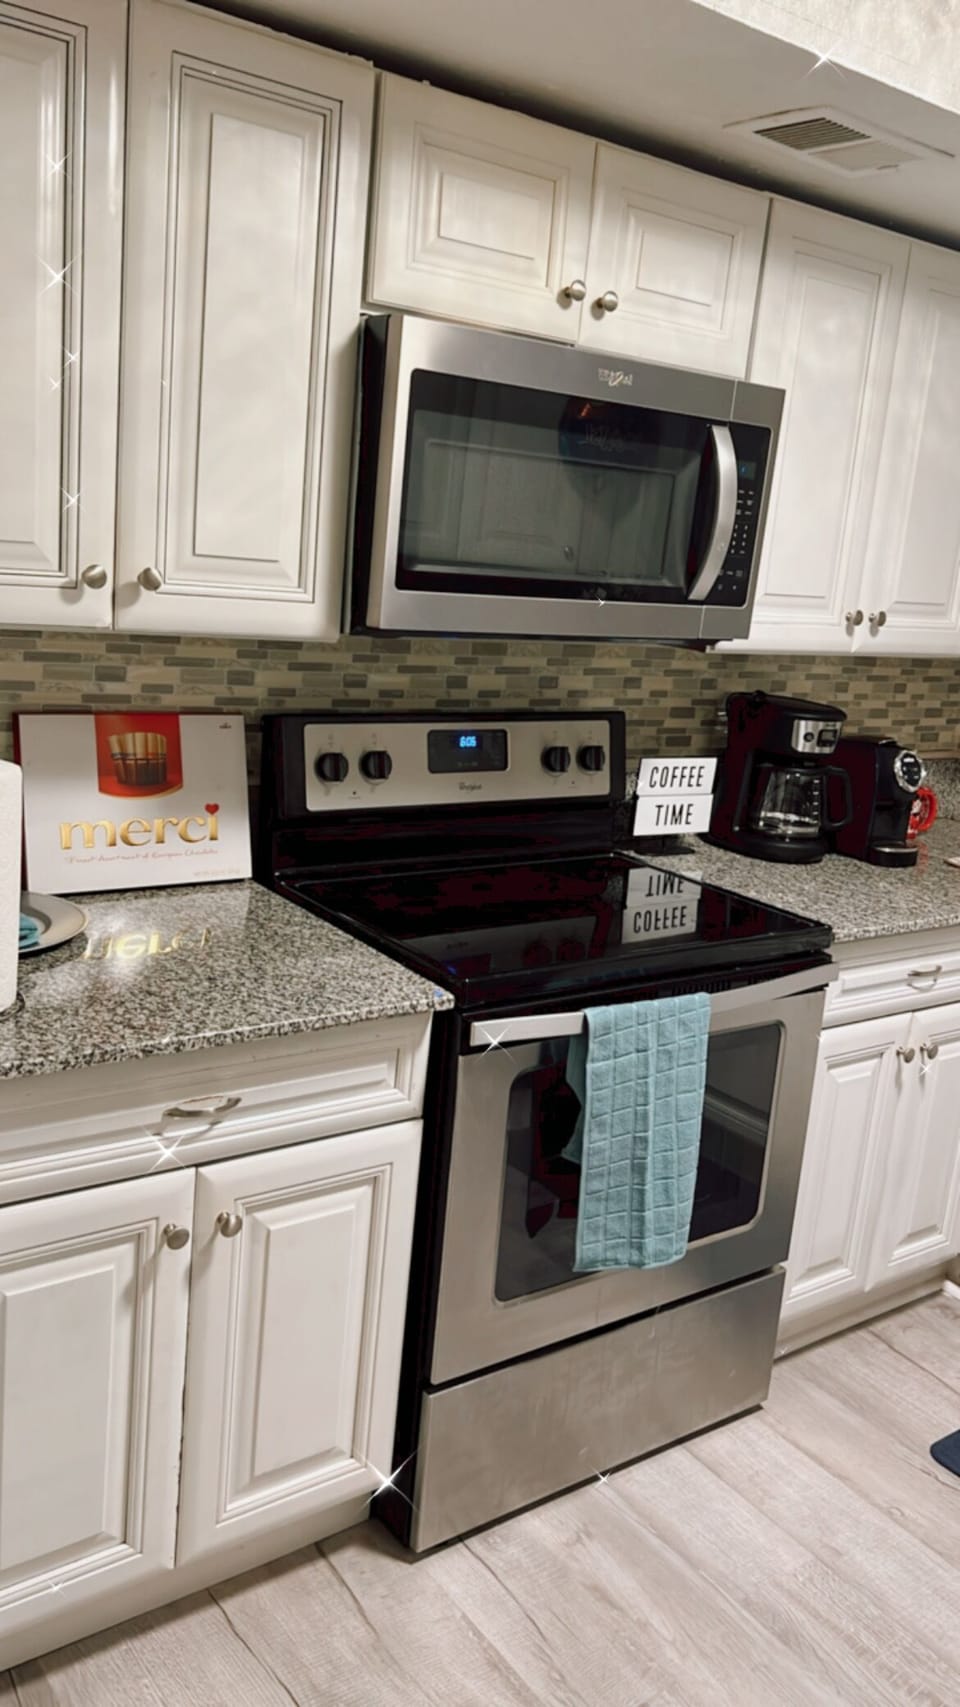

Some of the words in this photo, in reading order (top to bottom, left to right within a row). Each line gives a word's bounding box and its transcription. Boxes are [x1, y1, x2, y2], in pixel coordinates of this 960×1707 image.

[649, 766, 705, 788] COFFEE
[655, 803, 694, 826] TIME
[60, 803, 220, 850] merci
